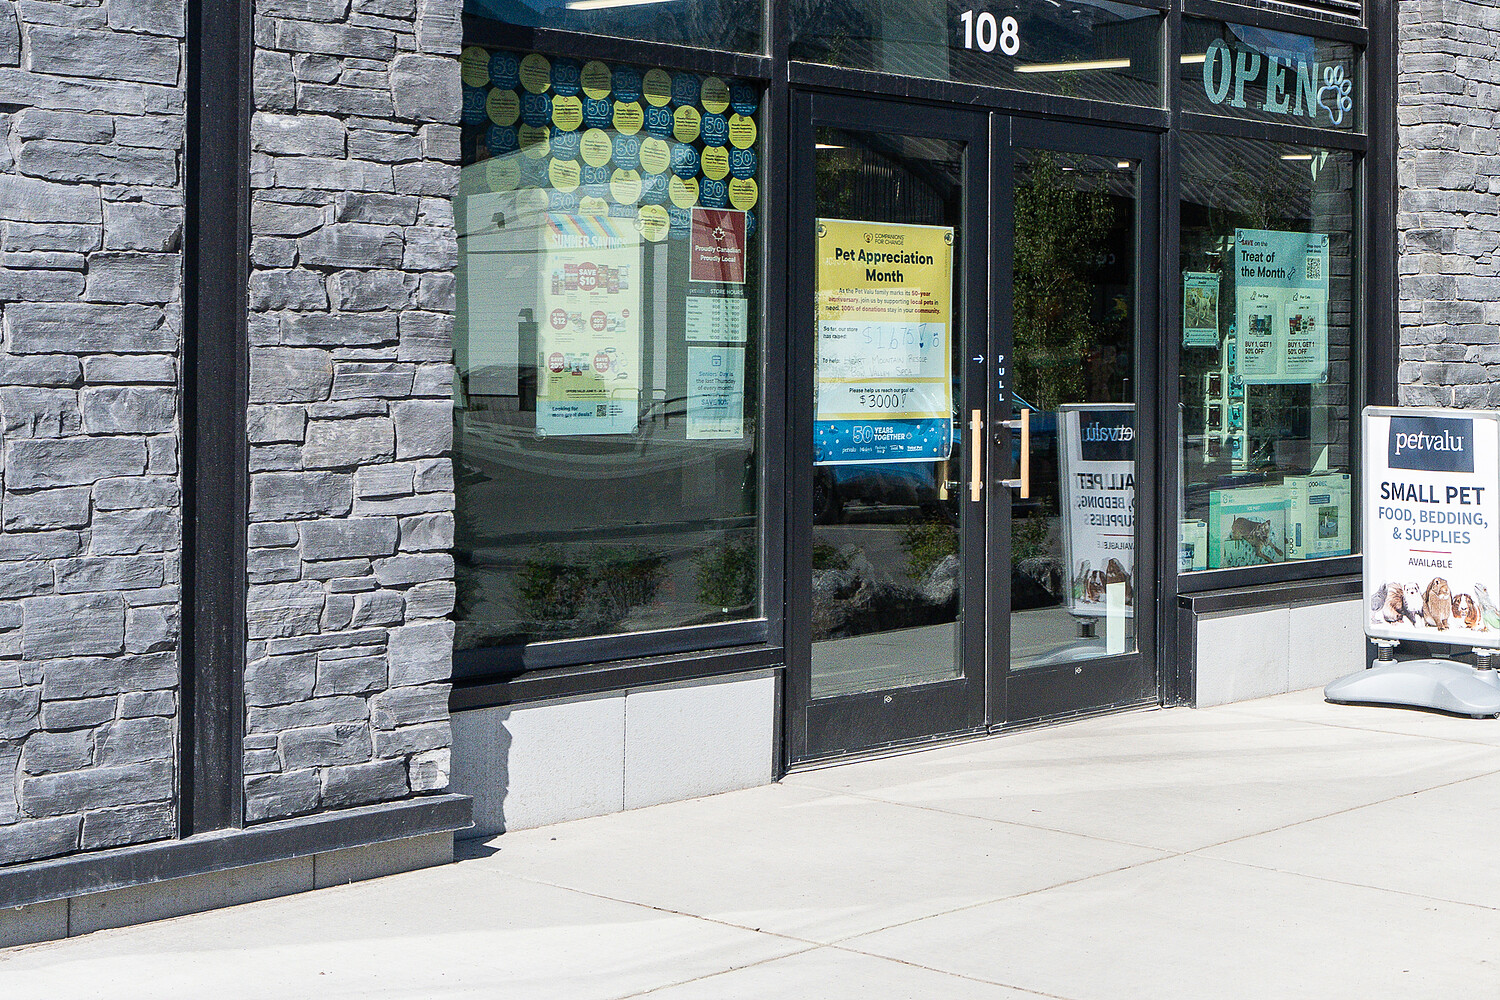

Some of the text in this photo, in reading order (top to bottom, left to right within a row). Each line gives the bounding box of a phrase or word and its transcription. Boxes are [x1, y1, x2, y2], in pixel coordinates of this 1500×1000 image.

[960, 10, 1020, 56] 108
[1203, 38, 1320, 118] OPEN
[587, 99, 609, 116] 50
[649, 108, 670, 126] 50
[705, 117, 725, 134] 50
[616, 139, 638, 157] 50
[674, 149, 696, 166] 50
[733, 150, 753, 166] 50
[584, 165, 607, 184] 50
[704, 180, 724, 197] 50
[552, 234, 591, 249] SUMMER
[695, 245, 716, 253] Proudly
[835, 248, 856, 261] Pet
[858, 249, 934, 265] Appreciation
[1241, 249, 1276, 263] Treat of
[578, 268, 597, 276] SAVE
[866, 269, 904, 282] Month
[1240, 265, 1286, 279] the Month
[580, 276, 596, 287] $10
[852, 425, 874, 444] 50
[873, 433, 906, 441] TOGETHER
[874, 426, 894, 434] YEARS
[1394, 430, 1463, 455] petvalu
[1380, 481, 1485, 505] SMALL PET
[1378, 506, 1489, 529] FOOD, BEDDING,
[1392, 526, 1471, 544] & SUPPLIES
[1408, 557, 1453, 569] AVAILABLE
